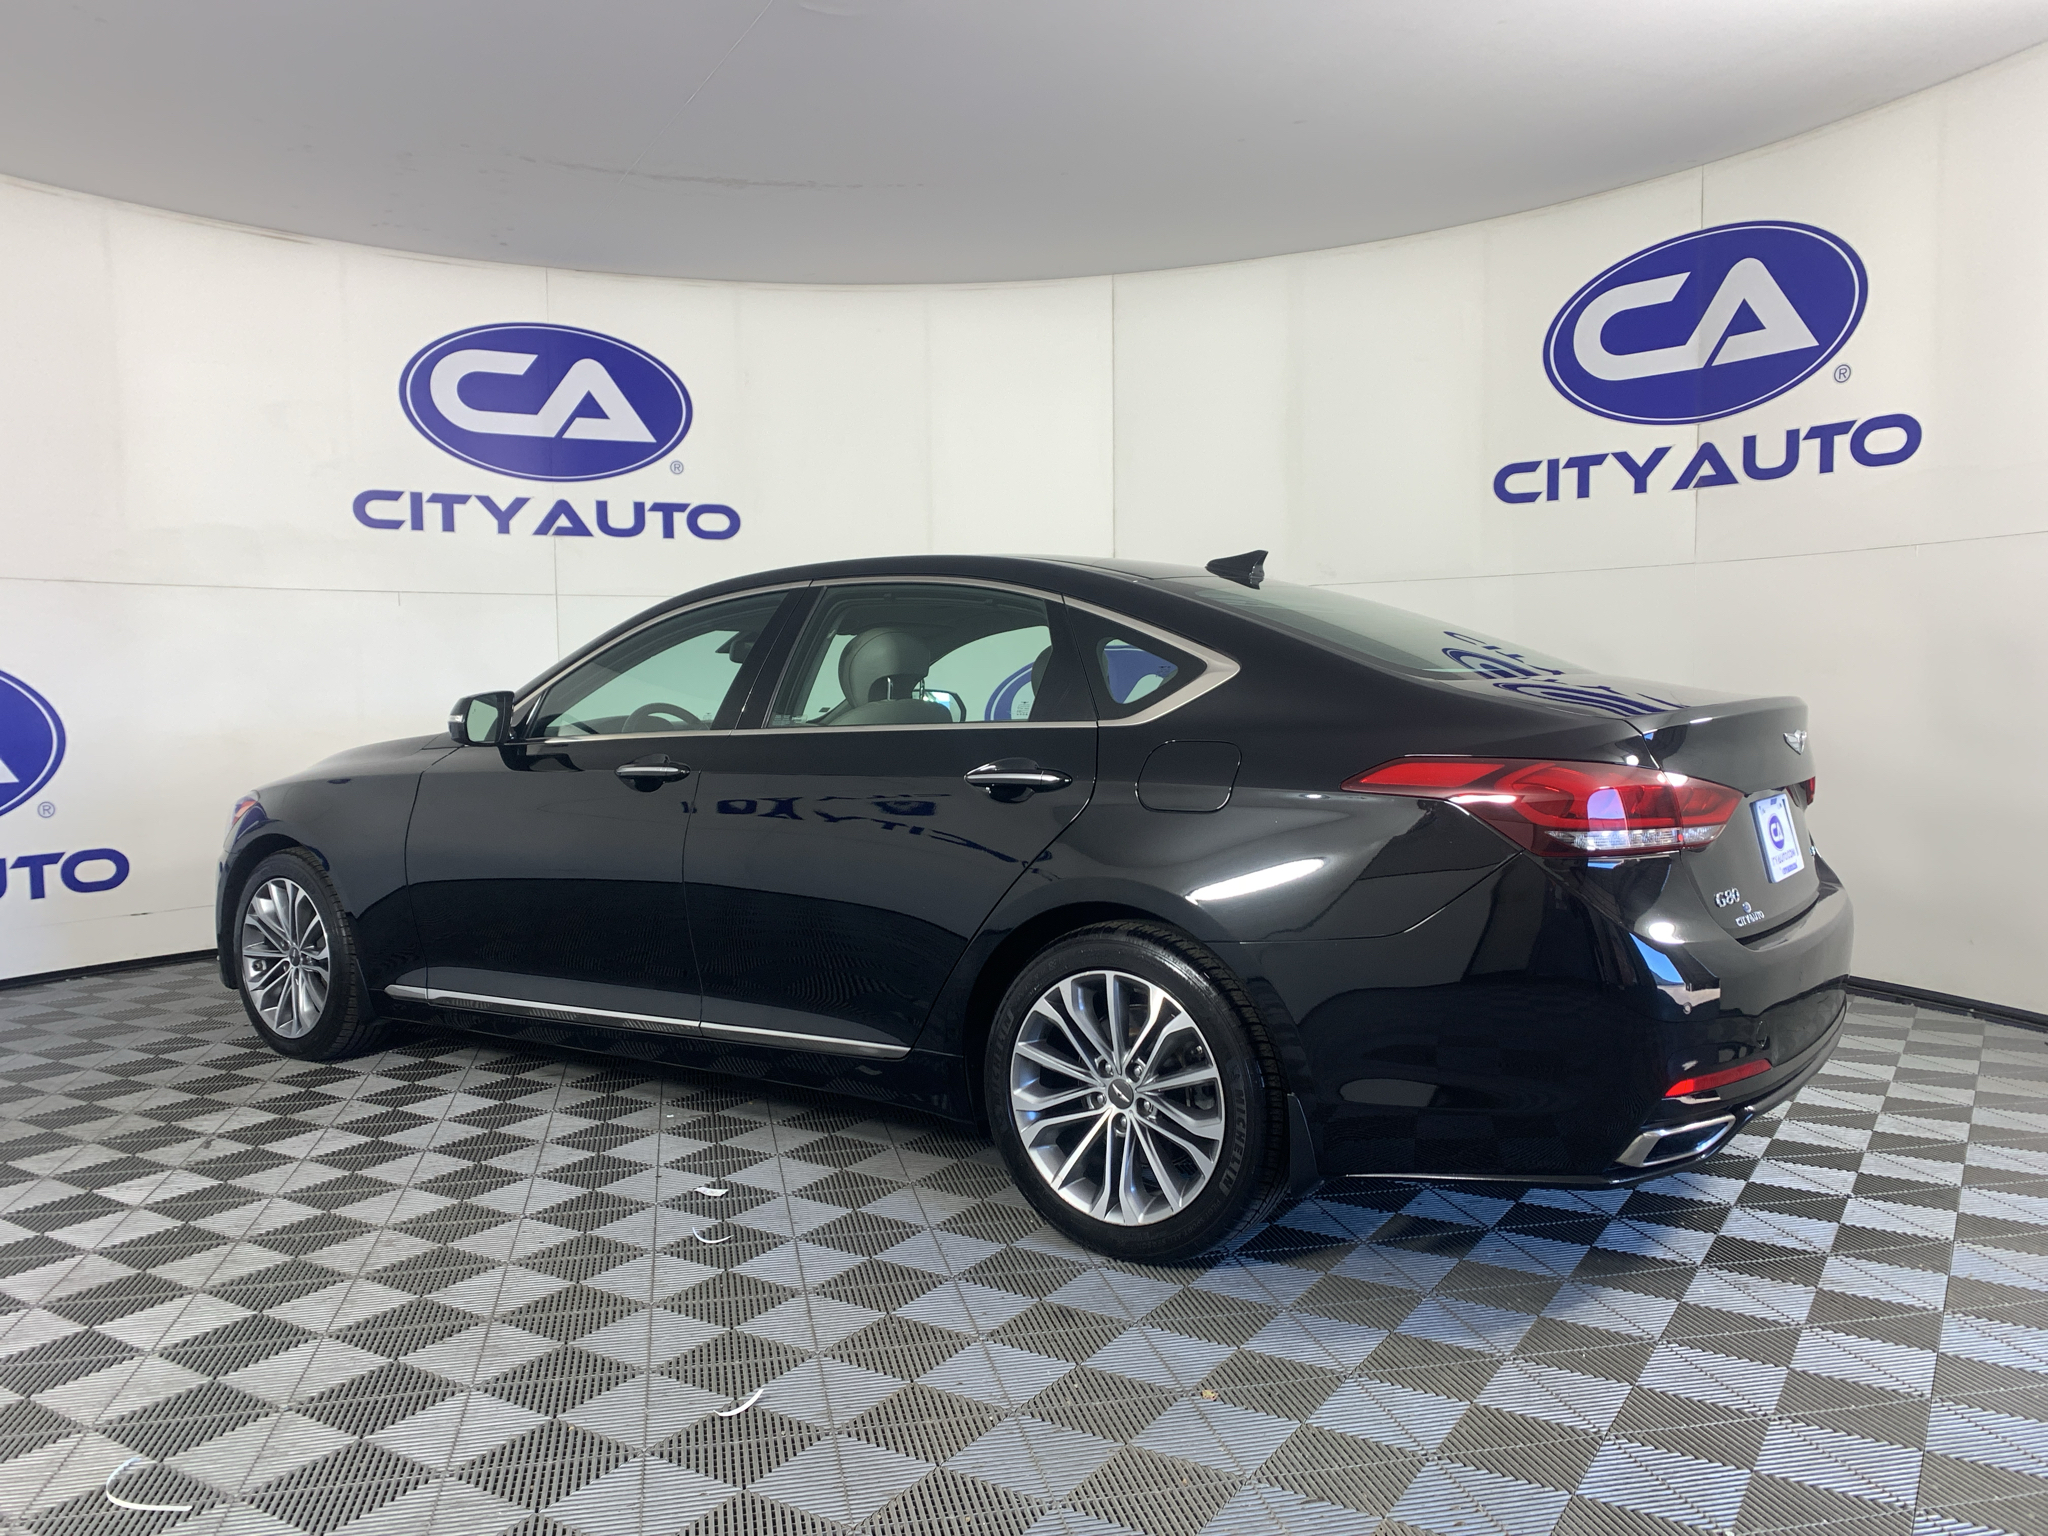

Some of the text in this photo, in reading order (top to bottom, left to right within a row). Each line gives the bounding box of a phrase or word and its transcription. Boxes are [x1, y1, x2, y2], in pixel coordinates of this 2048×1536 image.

[1573, 257, 1819, 381] CA
[430, 349, 657, 442] CA
[0, 847, 130, 900] TO
[1714, 887, 1740, 908] G80
[1220, 1087, 1246, 1192] MICHELIN
